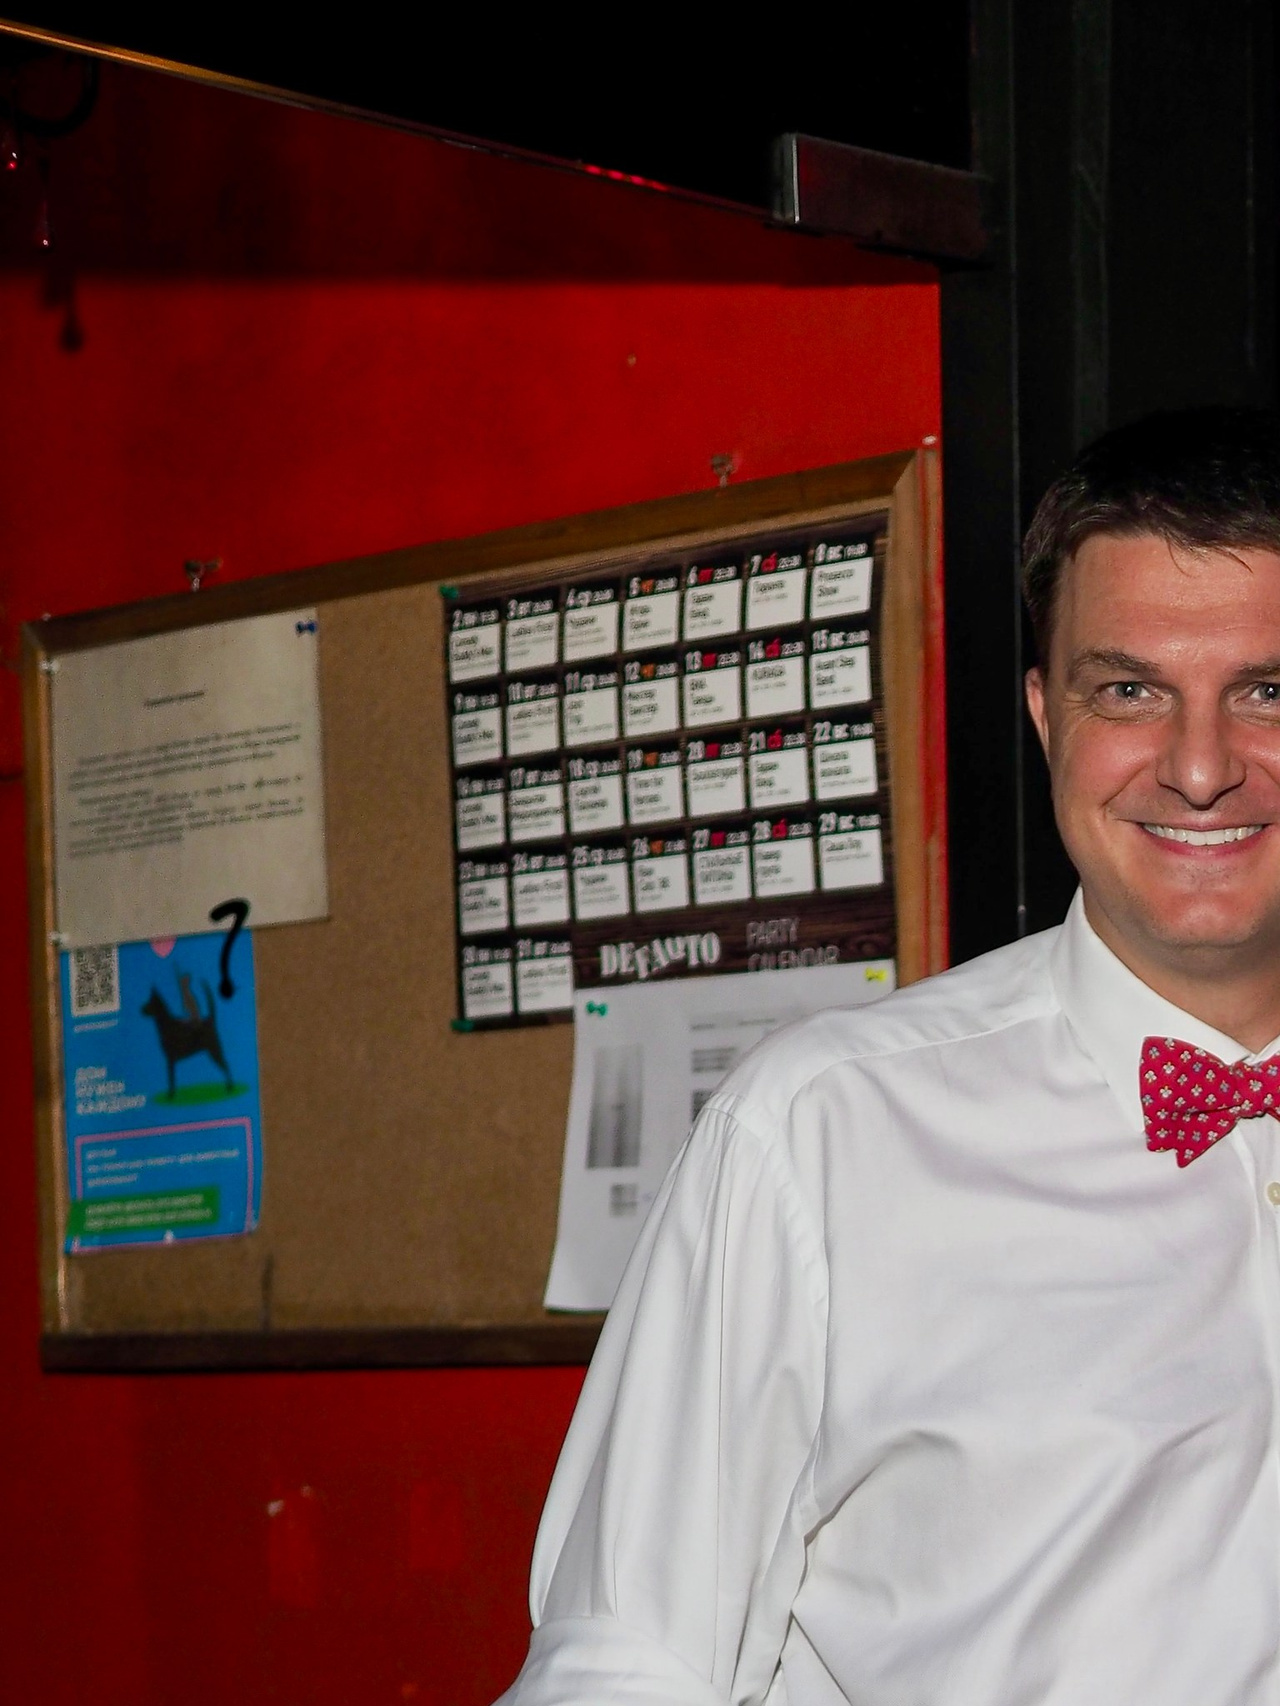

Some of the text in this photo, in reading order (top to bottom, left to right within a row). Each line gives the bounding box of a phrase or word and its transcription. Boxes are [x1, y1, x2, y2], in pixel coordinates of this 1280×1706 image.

[751, 554, 762, 574] 7
[747, 918, 800, 947] PARTY
[600, 931, 721, 979] DEFAUTO
